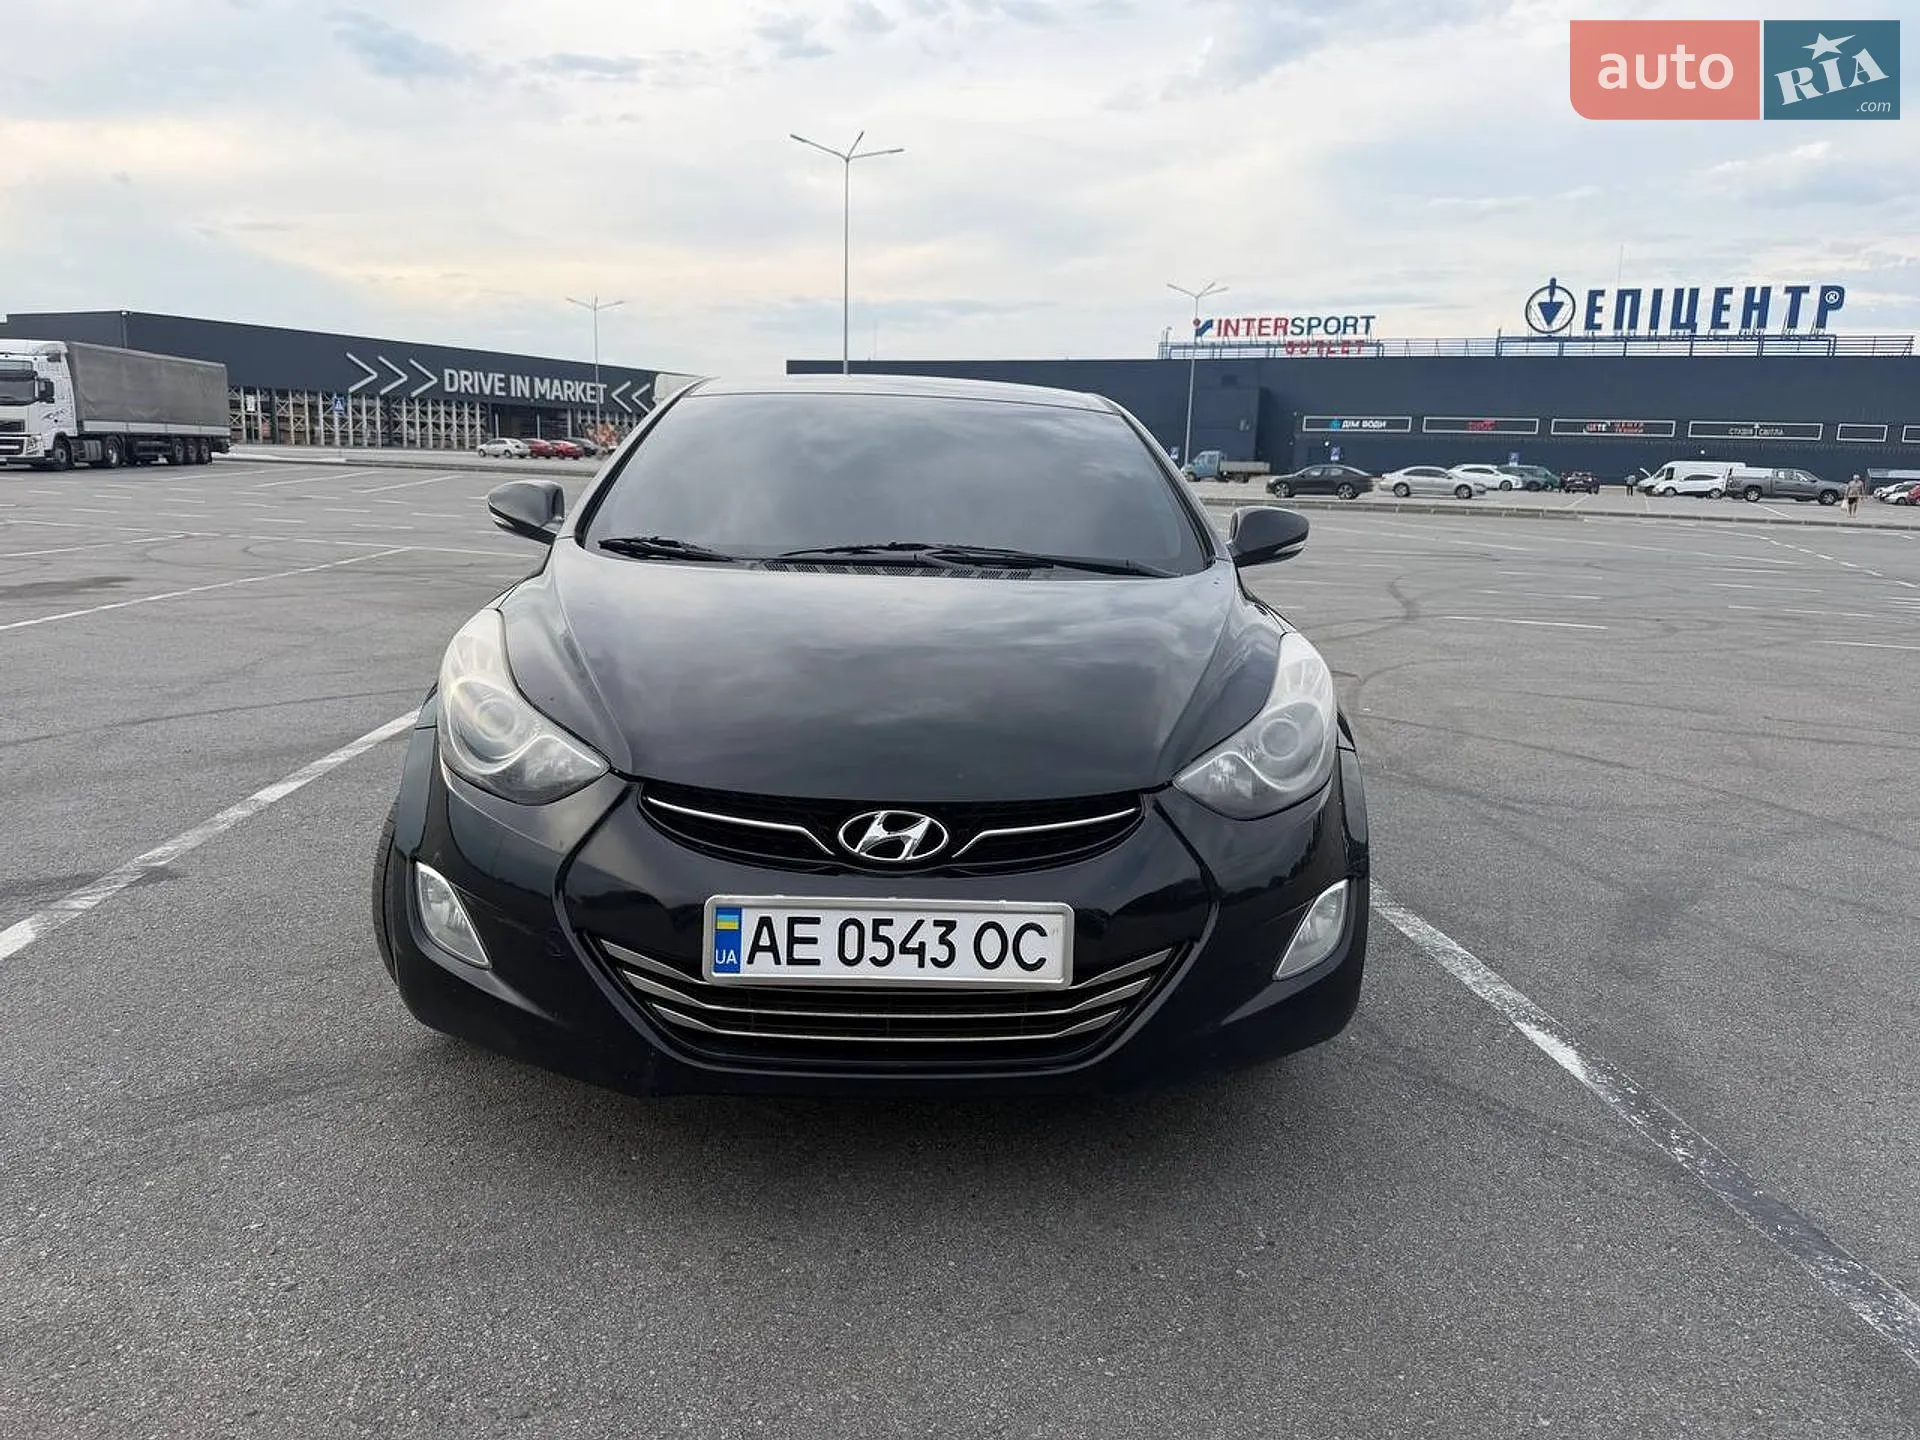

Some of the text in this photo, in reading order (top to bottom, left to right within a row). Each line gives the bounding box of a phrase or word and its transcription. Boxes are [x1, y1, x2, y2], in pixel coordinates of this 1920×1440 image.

[1216, 315, 1377, 338] INTERSPORT
[1285, 339, 1365, 355] OUTLET
[444, 368, 608, 405] DRIVE IN MARKET
[715, 915, 1048, 972] UA AE 0543 OC
